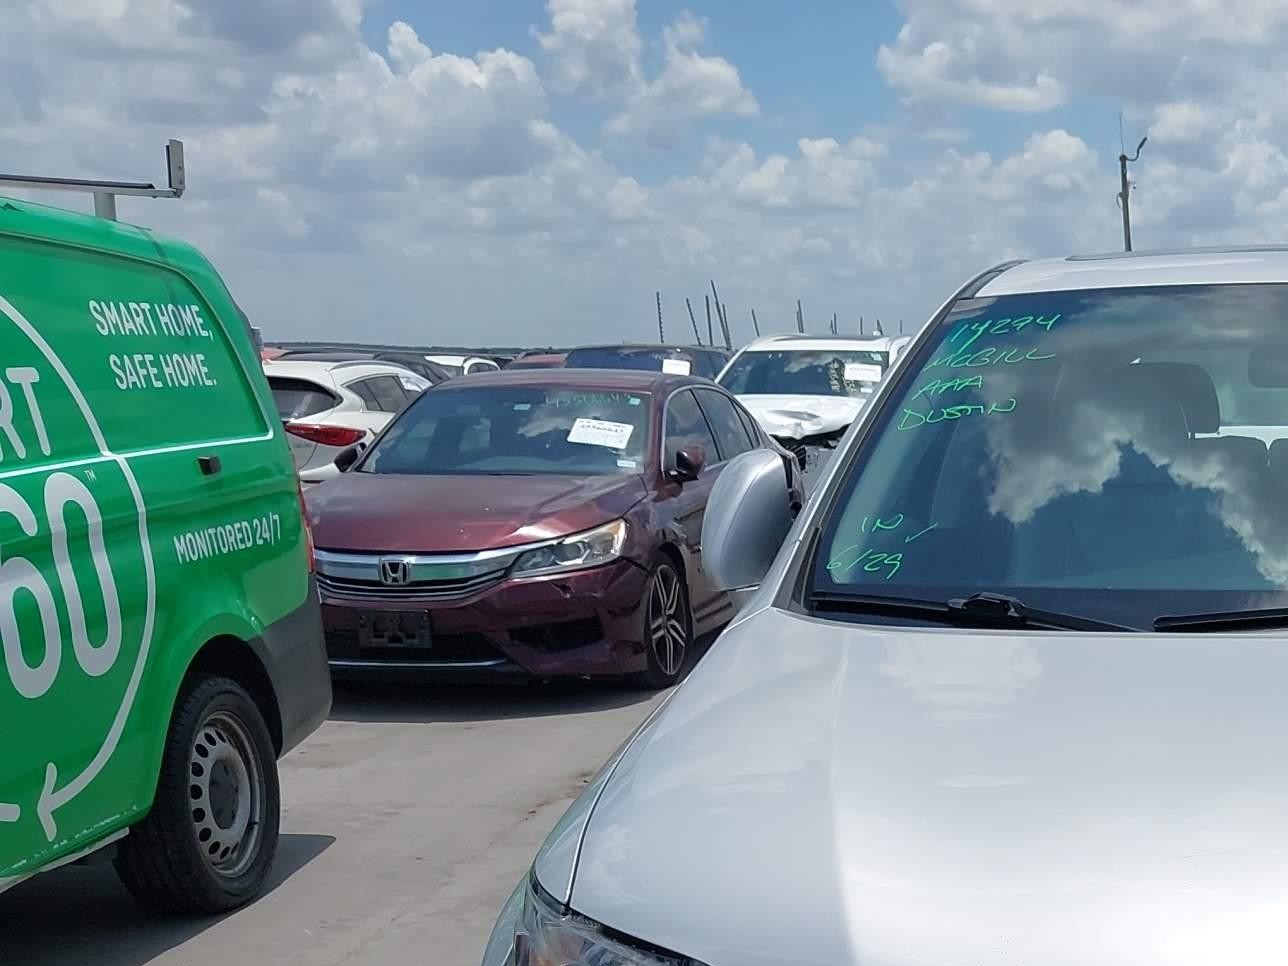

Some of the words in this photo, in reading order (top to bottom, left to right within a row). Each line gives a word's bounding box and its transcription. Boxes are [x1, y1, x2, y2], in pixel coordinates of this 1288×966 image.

[89, 300, 157, 336] SMART
[156, 303, 214, 341] HOME,
[109, 354, 163, 390] SAFE
[162, 353, 217, 387] HOME.
[911, 374, 983, 401] AAA
[897, 398, 1016, 431] DUSTIN
[173, 519, 252, 565] MONITORED
[252, 512, 282, 547] 24/7
[861, 512, 904, 532] IN
